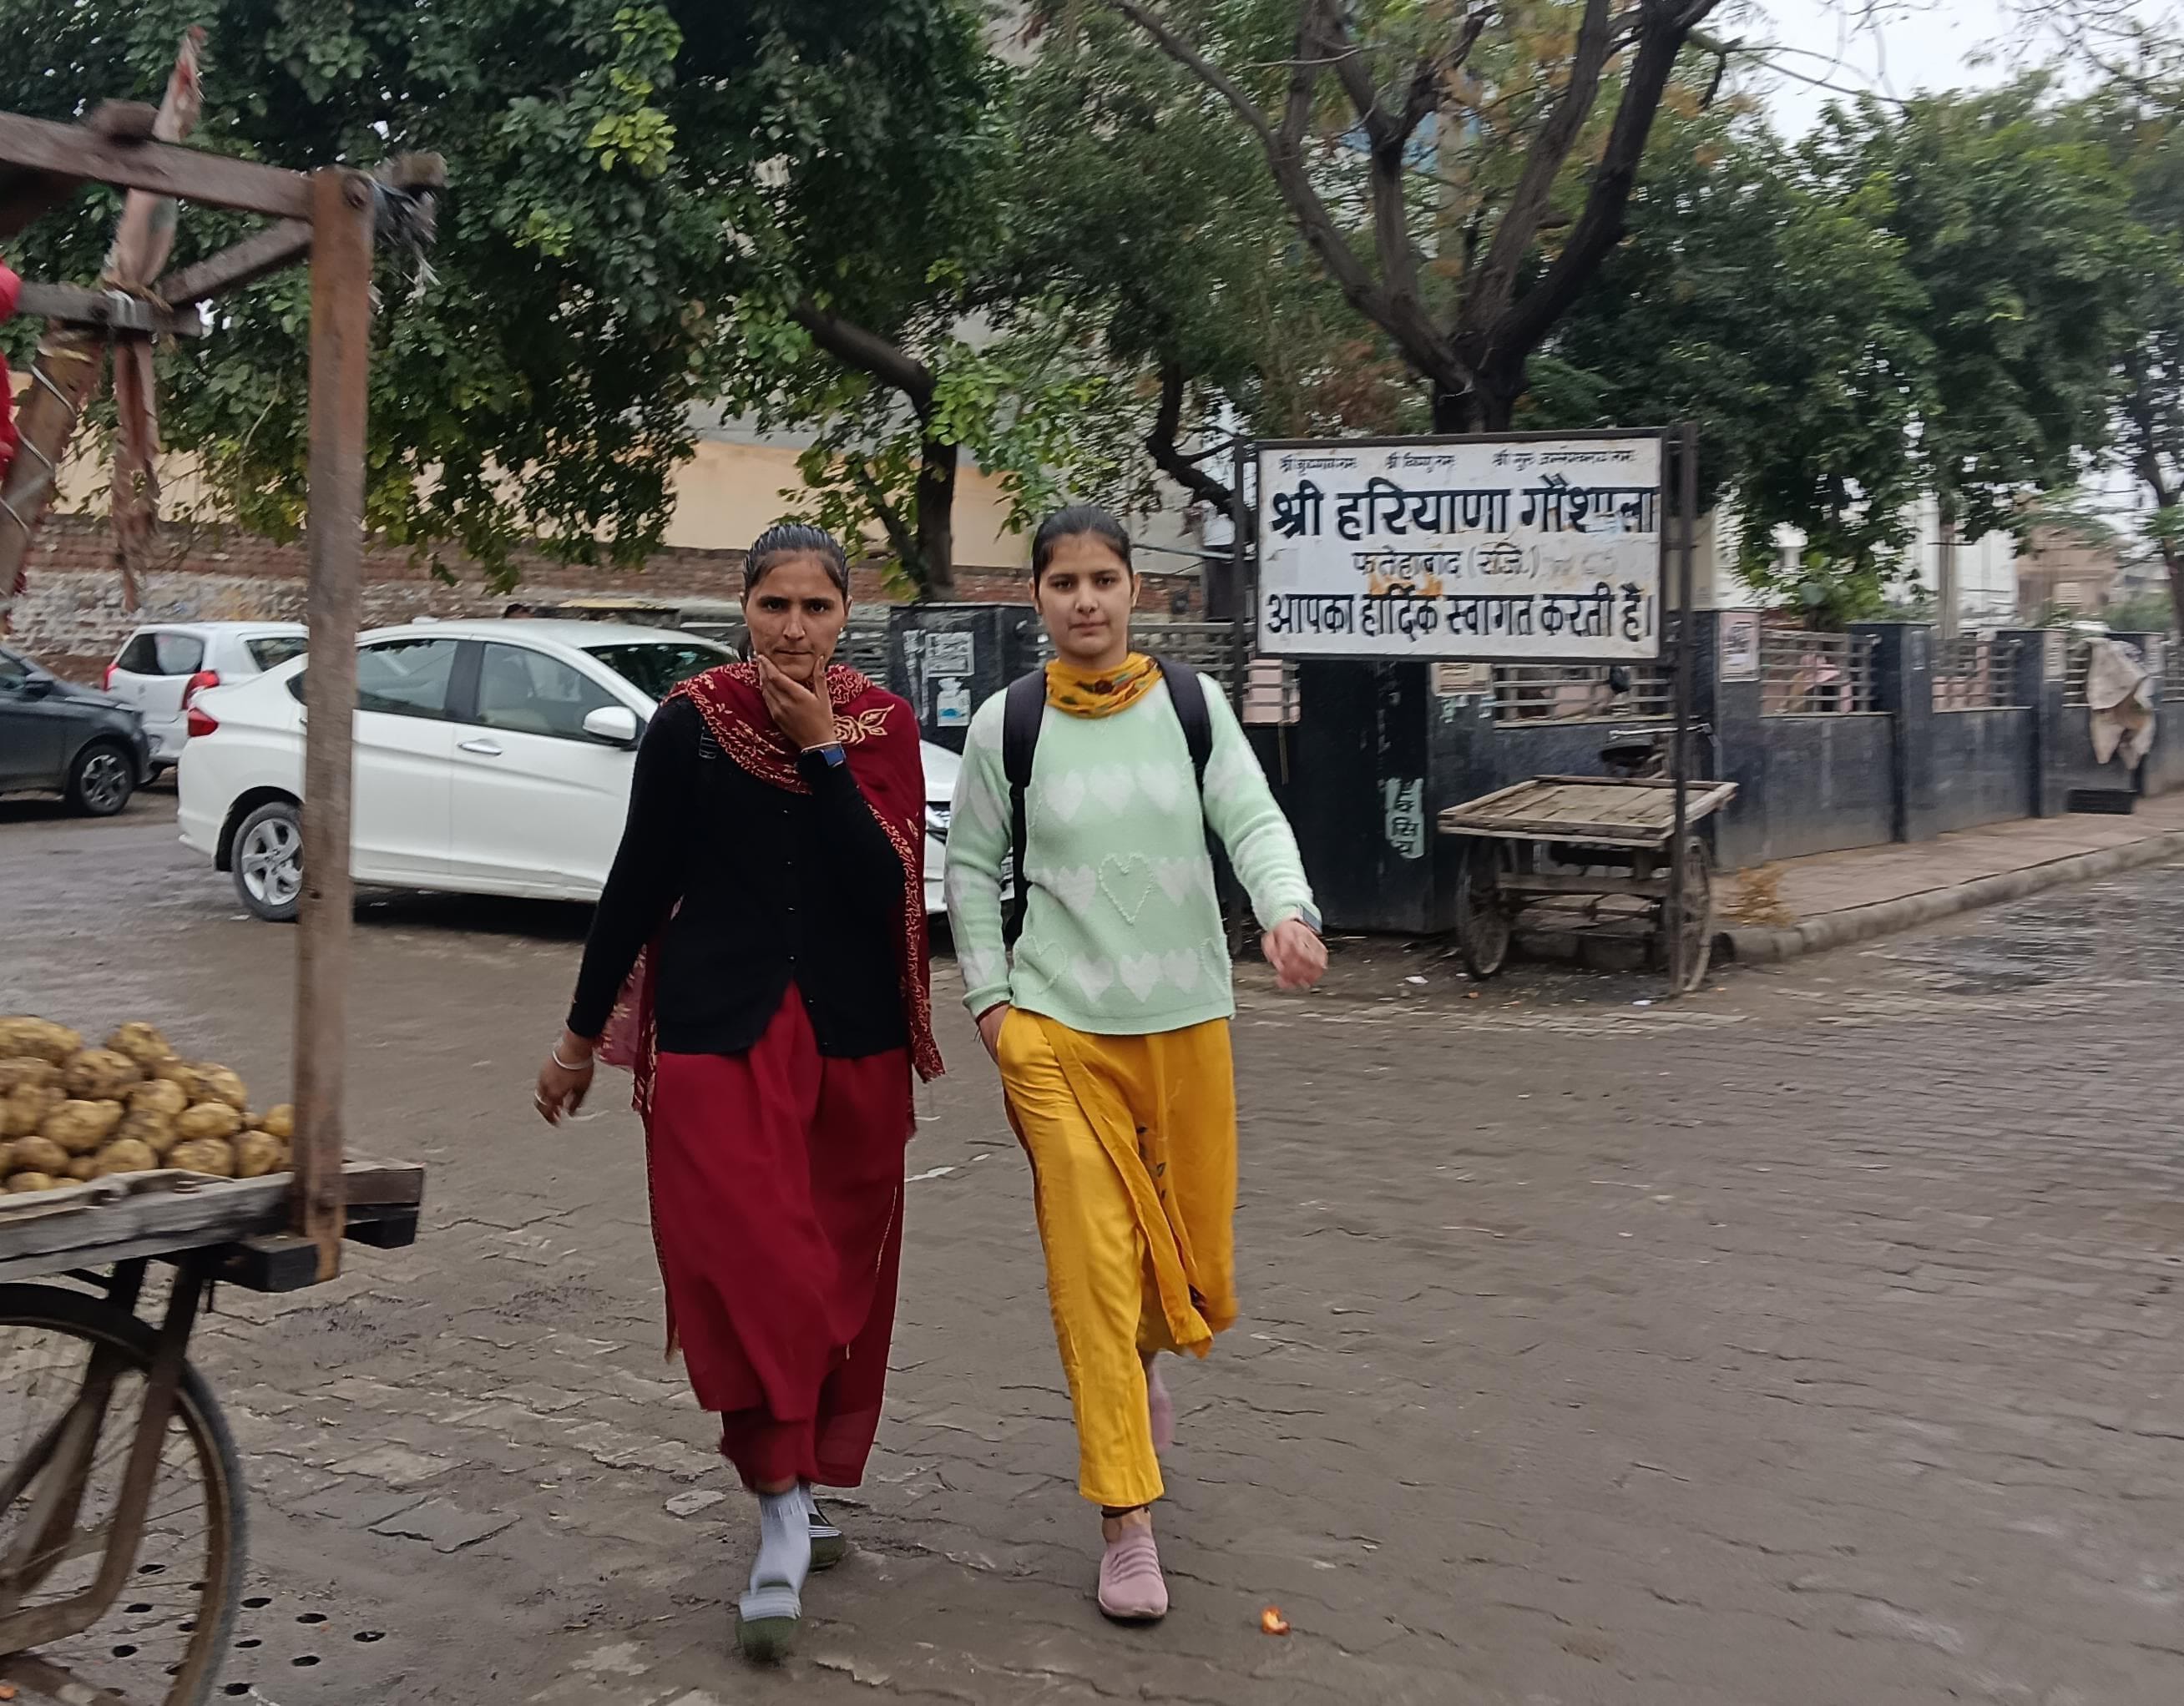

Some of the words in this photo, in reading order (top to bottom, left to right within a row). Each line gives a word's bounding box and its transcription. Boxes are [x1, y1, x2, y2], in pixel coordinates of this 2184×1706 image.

[1268, 479, 1325, 540] श्री
[1336, 476, 1512, 541] हरियाणा
[1266, 593, 1355, 634] आपका
[1361, 583, 1438, 643] हार्दिक
[1445, 593, 1534, 636] स्वागत
[1540, 581, 1615, 638] करती
